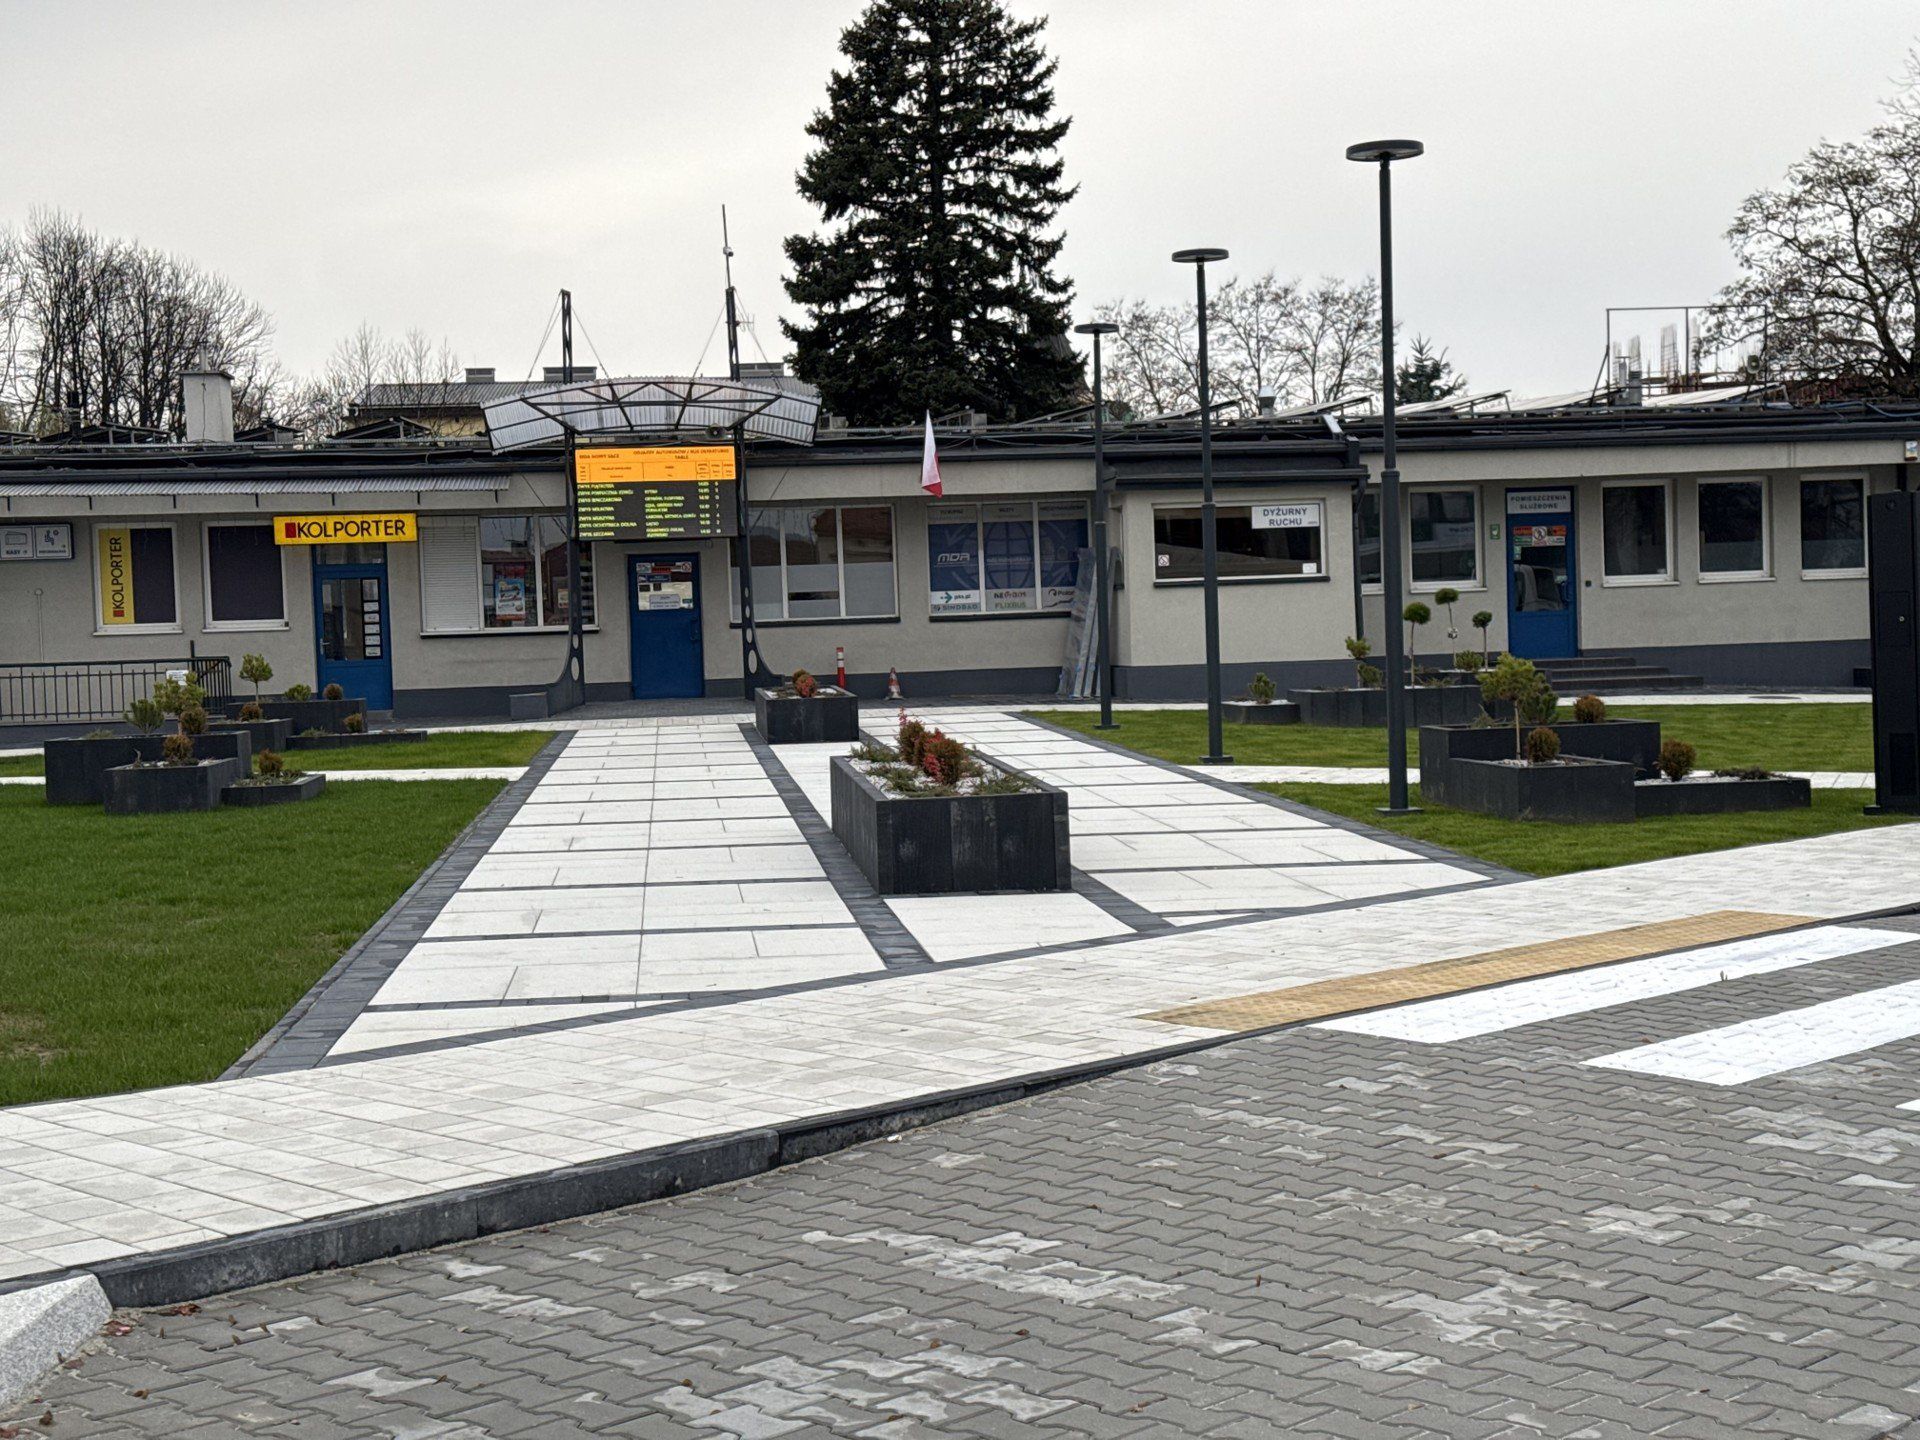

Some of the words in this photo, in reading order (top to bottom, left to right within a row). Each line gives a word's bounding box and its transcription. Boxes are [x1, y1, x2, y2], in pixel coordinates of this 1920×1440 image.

[1510, 494, 1567, 502] POMIESZCZENIA
[1519, 502, 1559, 510] SŁUŻBOWE
[1263, 506, 1307, 517] DYŻURNY
[1269, 518, 1302, 526] RUCHU
[297, 519, 406, 538] KOLPORTER
[937, 553, 970, 563] MDA
[109, 537, 125, 609] KOLPORTER
[995, 601, 1026, 609] FLIXBUS
